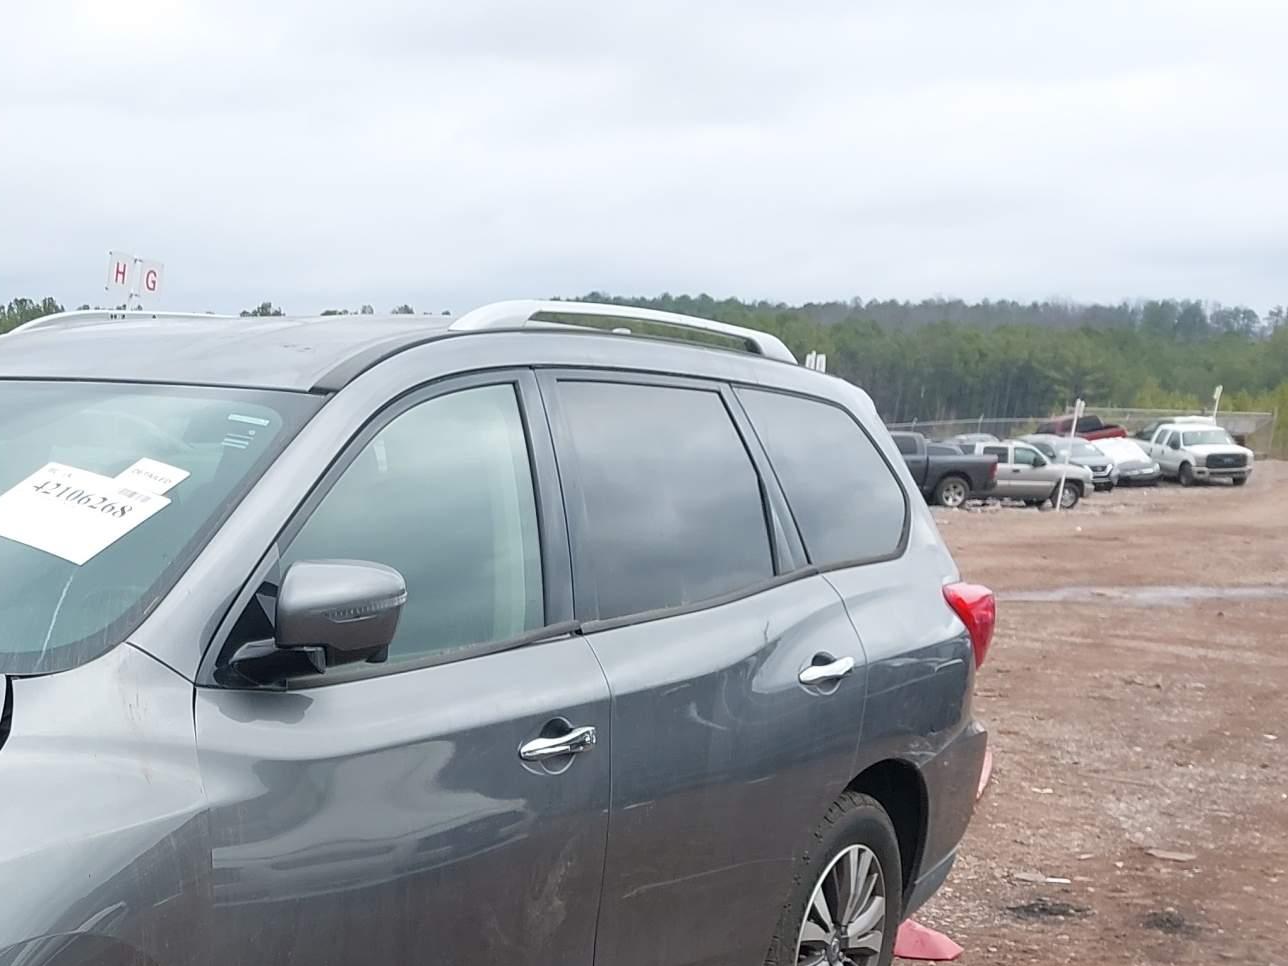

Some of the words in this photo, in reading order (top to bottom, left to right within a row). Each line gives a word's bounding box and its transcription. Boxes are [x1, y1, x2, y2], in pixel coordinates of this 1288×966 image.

[115, 261, 127, 285] H
[145, 270, 158, 291] G
[32, 480, 133, 518] 42106268
